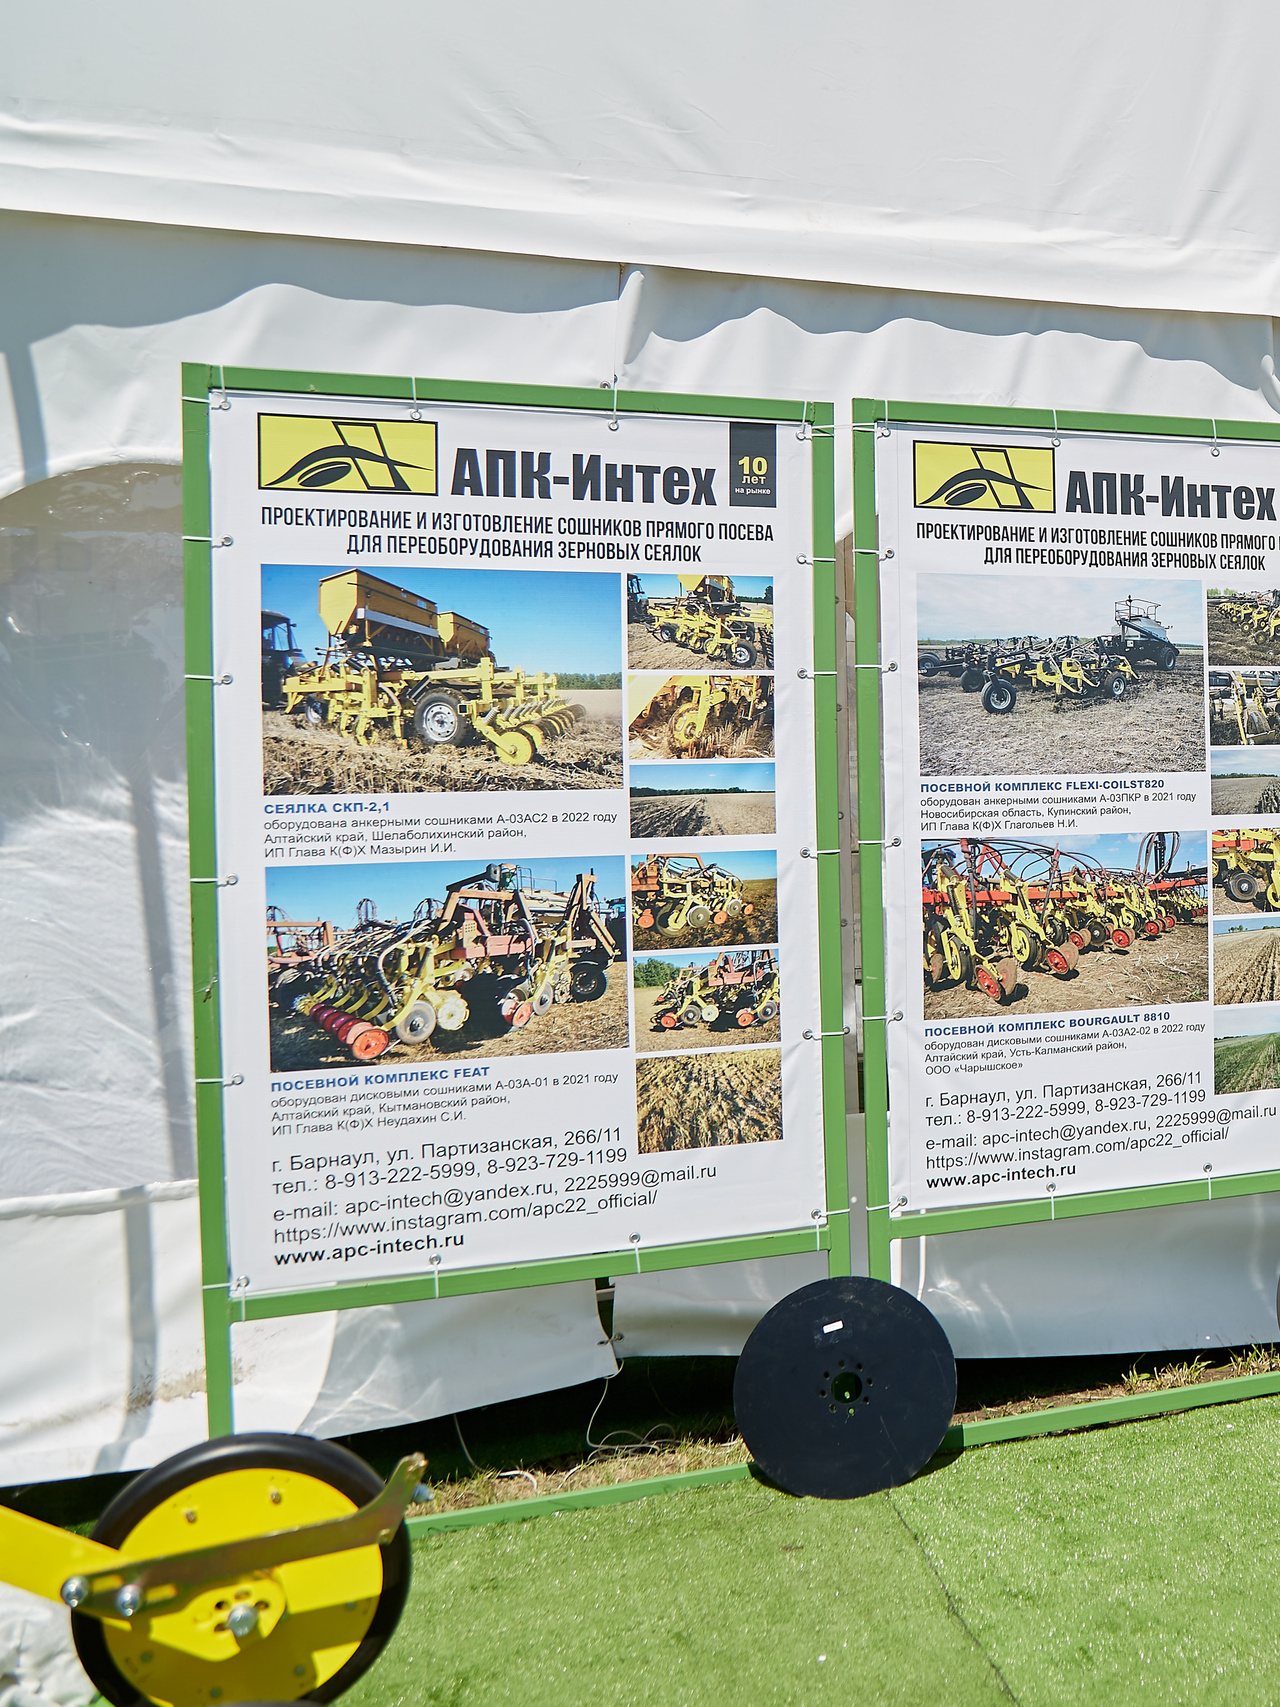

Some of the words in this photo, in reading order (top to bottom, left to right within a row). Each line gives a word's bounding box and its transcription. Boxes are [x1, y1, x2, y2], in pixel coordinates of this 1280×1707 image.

[452, 447, 717, 507] АПК-Интех
[738, 456, 768, 475] 10
[741, 476, 767, 485] лет
[1066, 470, 1277, 521] АПК-Интех
[262, 506, 412, 529] ПРОЕКТИРОВАНИЕ
[417, 511, 427, 530] И
[432, 512, 553, 534] ИЗГОТОВЛЕНИЕ
[558, 517, 642, 537] СОШНИКОВ
[646, 520, 714, 540] ПРЯМОГО
[719, 523, 774, 541] ПОСЕВА
[917, 522, 1035, 543] ПРОЕКТИРОВАНИЕ
[1039, 527, 1047, 543] И
[1051, 527, 1148, 546] ИЗГОТОВЛЕНИЕ
[1150, 531, 1218, 548] СОШНИКОВ
[1221, 533, 1276, 551] ПРЯМОГО
[346, 534, 382, 555] ДЛЯ
[387, 535, 553, 558] ПЕРЕОБОРУДОВАНИЯ
[558, 541, 640, 561] ЗЕРНОВЫХ
[644, 544, 702, 562] СЕЯЛОК
[984, 547, 1012, 565] ДЛЯ
[1016, 548, 1148, 568] ПЕРЕОБОРУДОВАНИЯ
[1151, 552, 1217, 569] ЗЕРНОВЫХ
[1220, 554, 1266, 571] СЕЯЛОК
[921, 781, 991, 793] ПОСЕВНОЙ
[995, 782, 1062, 792] КОМПЛЕКС
[1066, 779, 1164, 790] FLEXI-COILST820
[264, 803, 327, 814] СЕЯЛКА
[332, 802, 389, 814] СКП-2,1
[920, 797, 981, 808] оборудован
[983, 797, 1039, 807] анкерными
[1042, 796, 1097, 804] сошниками
[1152, 792, 1173, 801] 2021
[1177, 793, 1196, 802] году
[921, 809, 999, 820] Новосибирская
[1002, 808, 1044, 817] область,
[1047, 806, 1097, 818] Купинский
[1100, 806, 1131, 817] район,
[264, 819, 347, 832] оборудована
[351, 818, 421, 829] анкерными
[424, 817, 493, 826] сошниками
[552, 815, 558, 823] в
[562, 812, 589, 822] 2022
[593, 814, 617, 824] году
[921, 822, 936, 831] ИП
[940, 821, 969, 831] Глава
[973, 821, 1002, 832] К(Ф)Х
[1005, 820, 1054, 829] Глагольев
[1057, 819, 1078, 828] Н.И.
[264, 833, 331, 844] Алтайский
[336, 832, 367, 844] край,
[372, 828, 484, 841] Шелаболихинский
[488, 828, 527, 840] район,
[265, 847, 284, 858] ИП
[289, 847, 325, 857] Глава
[330, 845, 366, 858] К(Ф)Х
[370, 845, 426, 856] Мазырин
[430, 843, 456, 853] И.И.
[924, 1040, 984, 1052] оборудован
[986, 1037, 1042, 1048] дисковыми
[1045, 1032, 1099, 1043] сошниками
[1161, 1023, 1183, 1033] 2022
[1186, 1024, 1206, 1032] году
[925, 1022, 994, 1037] ПОСЕВНОЙ
[998, 1020, 1065, 1032] КОМПЛЕКС
[1069, 1014, 1140, 1028] BOURGAULT
[1143, 1012, 1170, 1022] 8810
[924, 1051, 978, 1063] Алтайский
[981, 1049, 1006, 1061] край,
[1009, 1043, 1093, 1057] Усть-Калманский
[1096, 1041, 1127, 1052] район,
[271, 1074, 359, 1092] ПОСЕВНОЙ
[365, 1070, 449, 1085] КОМПЛЕКС
[454, 1066, 490, 1078] FEAT
[925, 1065, 951, 1075] ООО
[954, 1062, 1023, 1074] «Чарышское»
[271, 1095, 346, 1108] оборудован
[350, 1089, 419, 1103] дисковыми
[423, 1083, 492, 1096] сошниками
[553, 1078, 559, 1086] в
[563, 1074, 589, 1085] 2021
[594, 1074, 618, 1084] году
[926, 1097, 934, 1107] г.
[940, 1091, 1010, 1108] Барнаул,
[1015, 1089, 1037, 1104] ул.
[1043, 1079, 1151, 1100] Партизанская,
[1156, 1071, 1200, 1088] 266/11
[271, 1107, 339, 1122] Алтайский
[343, 1104, 375, 1118] край,
[379, 1097, 467, 1113] Кытмановский
[471, 1095, 510, 1108] район,
[925, 1114, 961, 1127] тел.:
[967, 1100, 1090, 1123] 8-913-222-5999,
[1095, 1089, 1206, 1112] 8-923-729-1199
[272, 1125, 292, 1136] ИП
[296, 1123, 333, 1134] Глава
[337, 1118, 373, 1131] К(Ф)Х
[377, 1115, 437, 1128] Неудахин
[440, 1111, 466, 1122] С.И.
[926, 1133, 977, 1150] e-mail:
[982, 1120, 1151, 1148] apc-intech@yandex.ru,
[1156, 1105, 1276, 1128] 2225999@mail.ru
[272, 1161, 282, 1172] г.
[290, 1152, 379, 1172] Барнаул,
[386, 1149, 414, 1166] ул.
[422, 1136, 557, 1160] Партизанская,
[564, 1127, 620, 1146] 266/11
[926, 1126, 1229, 1171] https://www.instagram.com/apc22_official/
[272, 1179, 318, 1194] тел.:
[325, 1161, 480, 1190] 8-913-222-5999,
[487, 1147, 627, 1174] 8-923-729-1199
[926, 1165, 1076, 1189] www.apc-intech.ru
[273, 1201, 338, 1221] e-mail:
[345, 1183, 558, 1217] apc-intech@yandex.ru,
[564, 1165, 716, 1192] 2225999@mail.ru
[274, 1189, 658, 1245] https://www.instagram.com/apc22_official/
[274, 1234, 464, 1266] www.apc-intech.ru
